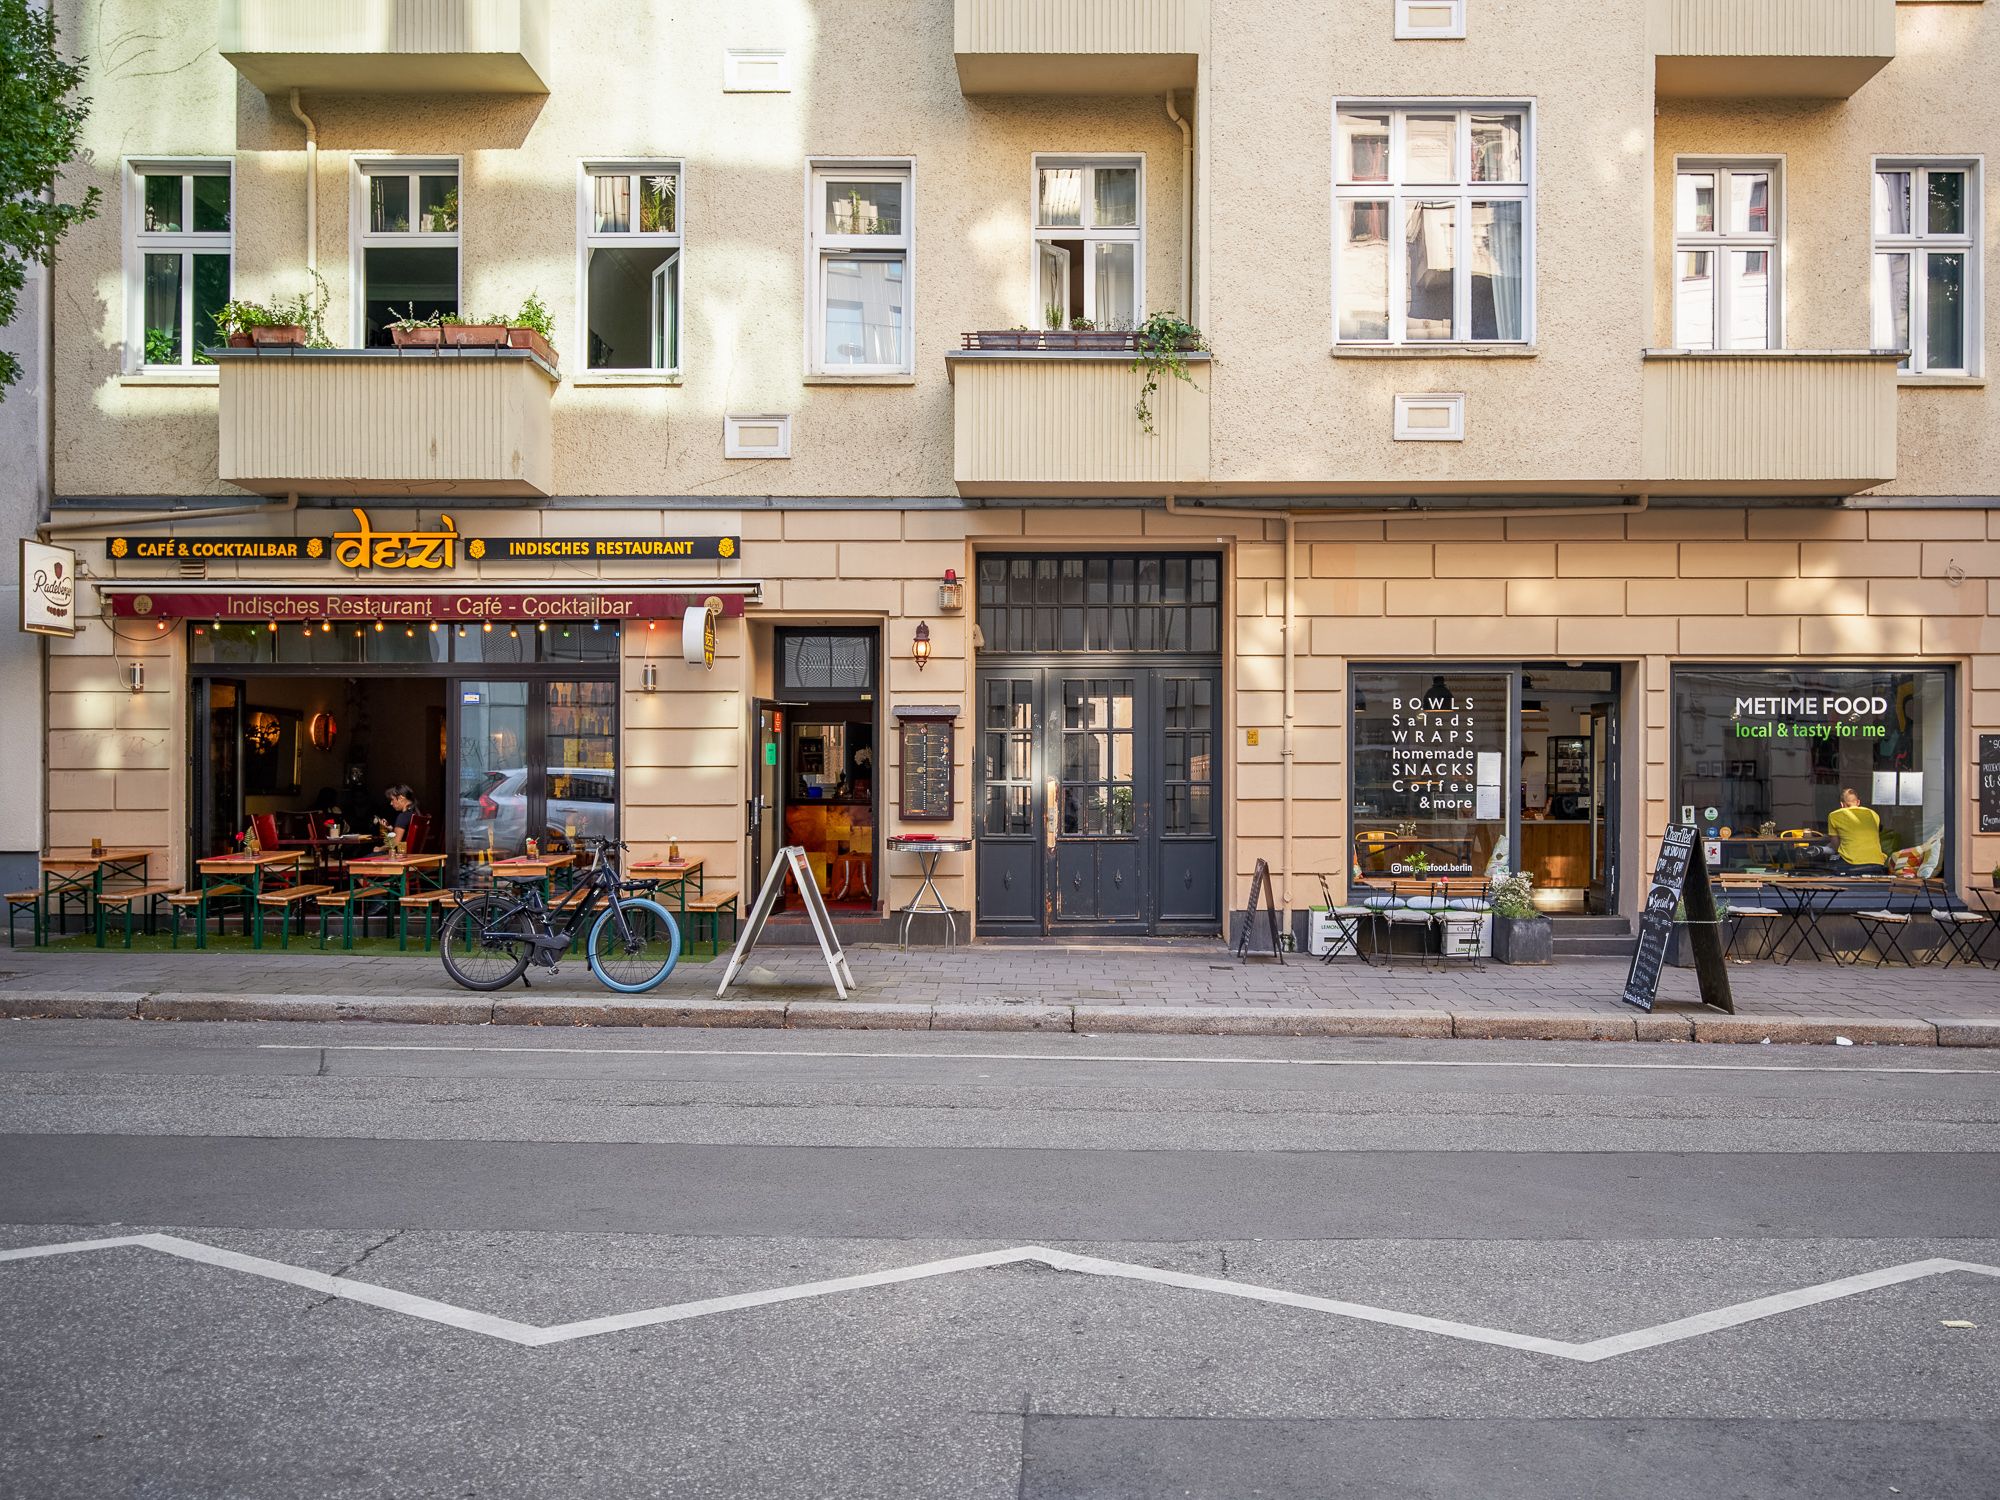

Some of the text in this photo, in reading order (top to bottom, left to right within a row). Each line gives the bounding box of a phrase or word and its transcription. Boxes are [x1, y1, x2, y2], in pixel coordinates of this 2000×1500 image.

[333, 508, 458, 569] dezi
[137, 539, 298, 557] CAFÉ & COCKTAILBAR
[509, 541, 694, 556] INDISCHES RESTAURANT
[228, 596, 320, 615] Indisches
[327, 596, 433, 615] Restaurant
[456, 597, 502, 616] Café
[522, 596, 633, 616] Cocktailbar
[1392, 697, 1474, 711] BOWLS
[1736, 696, 1888, 715] METIME FOOD
[1392, 713, 1474, 727] Salads
[1392, 731, 1474, 743] WRAPS
[1736, 721, 1886, 742] local & tasty for me
[1392, 746, 1474, 760] homemade
[1392, 763, 1474, 776] SNACKS
[1392, 780, 1474, 793] Coffee
[1433, 798, 1473, 809] more
